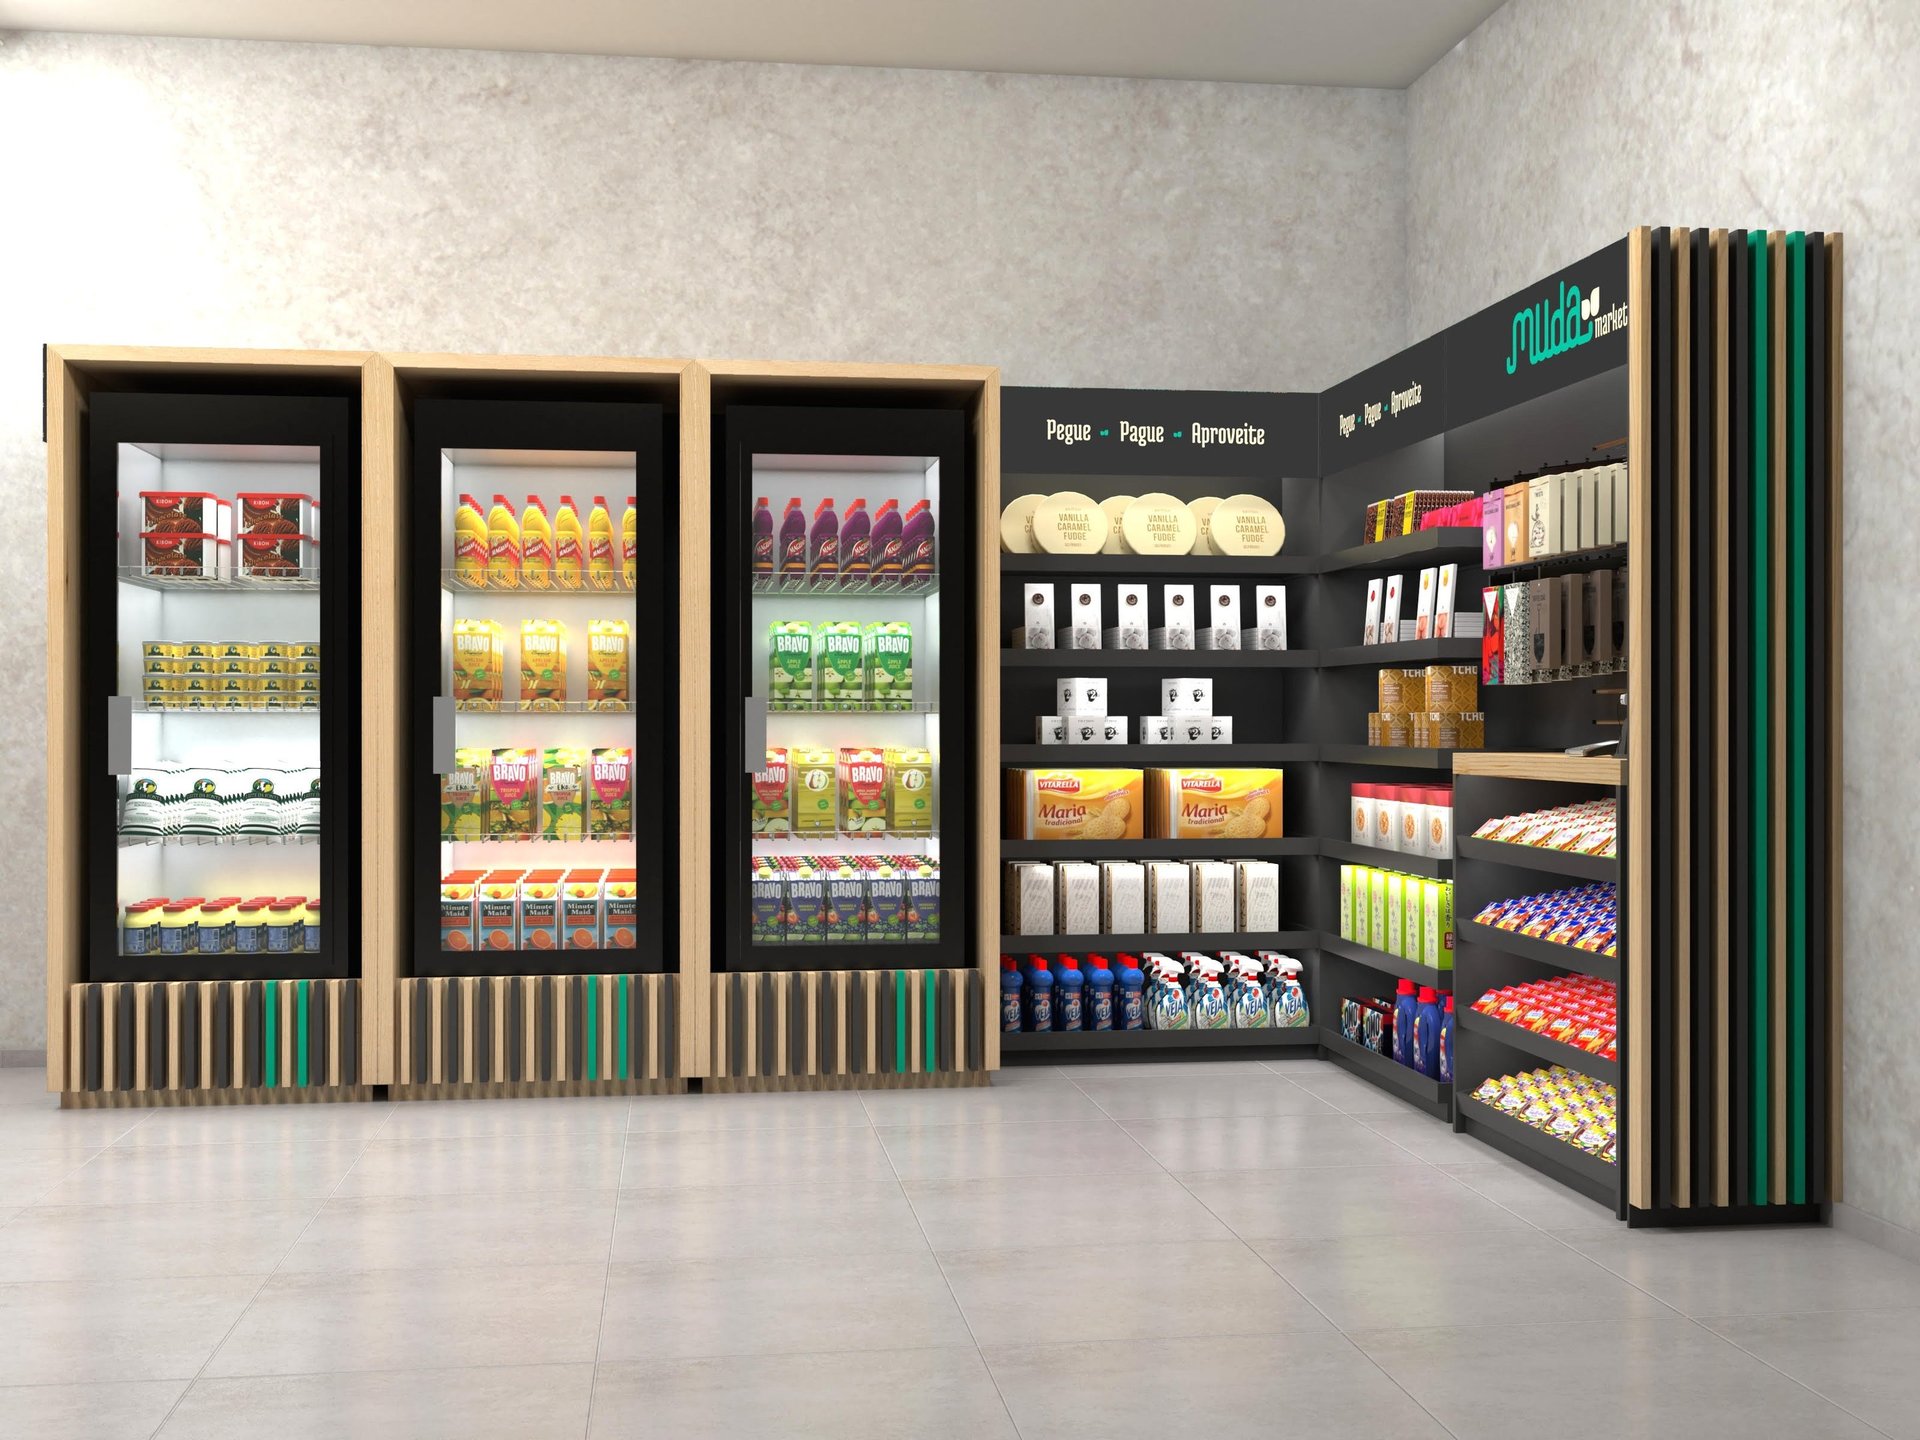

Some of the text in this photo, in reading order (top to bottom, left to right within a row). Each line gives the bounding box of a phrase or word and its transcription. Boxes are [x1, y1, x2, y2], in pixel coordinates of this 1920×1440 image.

[1594, 302, 1628, 339] market
[1339, 380, 1422, 438] Pegue Pague Aproveite
[1046, 418, 1265, 448] Pegue Pague Aproveite
[1058, 513, 1089, 522] VANILLA
[1148, 514, 1178, 523] VANILLA
[1236, 516, 1266, 524] VANILLA
[1057, 522, 1092, 531] CARAMEL
[1147, 523, 1181, 532] CARAMEL
[1235, 525, 1270, 533] CARAMEL
[1063, 532, 1087, 541] FUDGE
[1153, 533, 1176, 541] FUDGE
[1241, 534, 1265, 543] FUDGE
[457, 635, 489, 652] BRAVO
[525, 634, 557, 652] BRAVO
[592, 634, 624, 652] BRAVO
[777, 635, 809, 653] BRAVO
[828, 635, 859, 653] BRAVO
[878, 635, 909, 654] BRAVO
[493, 764, 526, 782] BRAVO
[549, 771, 575, 785] BRAVO
[593, 764, 626, 781] BRAVO
[851, 765, 883, 783] BRAVO
[1039, 780, 1079, 789] VITARELLA
[1182, 780, 1221, 788] VITARELLA
[1038, 803, 1086, 819] Maria
[1181, 803, 1228, 818] Maria
[1044, 817, 1083, 826] tradicional
[1188, 816, 1225, 825] tradicional
[791, 882, 822, 899] BRAVO
[831, 881, 862, 898] BRAVO
[871, 881, 902, 898] BRAVO
[1165, 1000, 1183, 1018] VEJA
[1205, 999, 1223, 1017] VEJA
[1245, 998, 1262, 1016] VEJA
[1285, 998, 1302, 1015] VEJA
[1344, 1003, 1358, 1029] OMO
[1366, 1013, 1380, 1039] OMO
